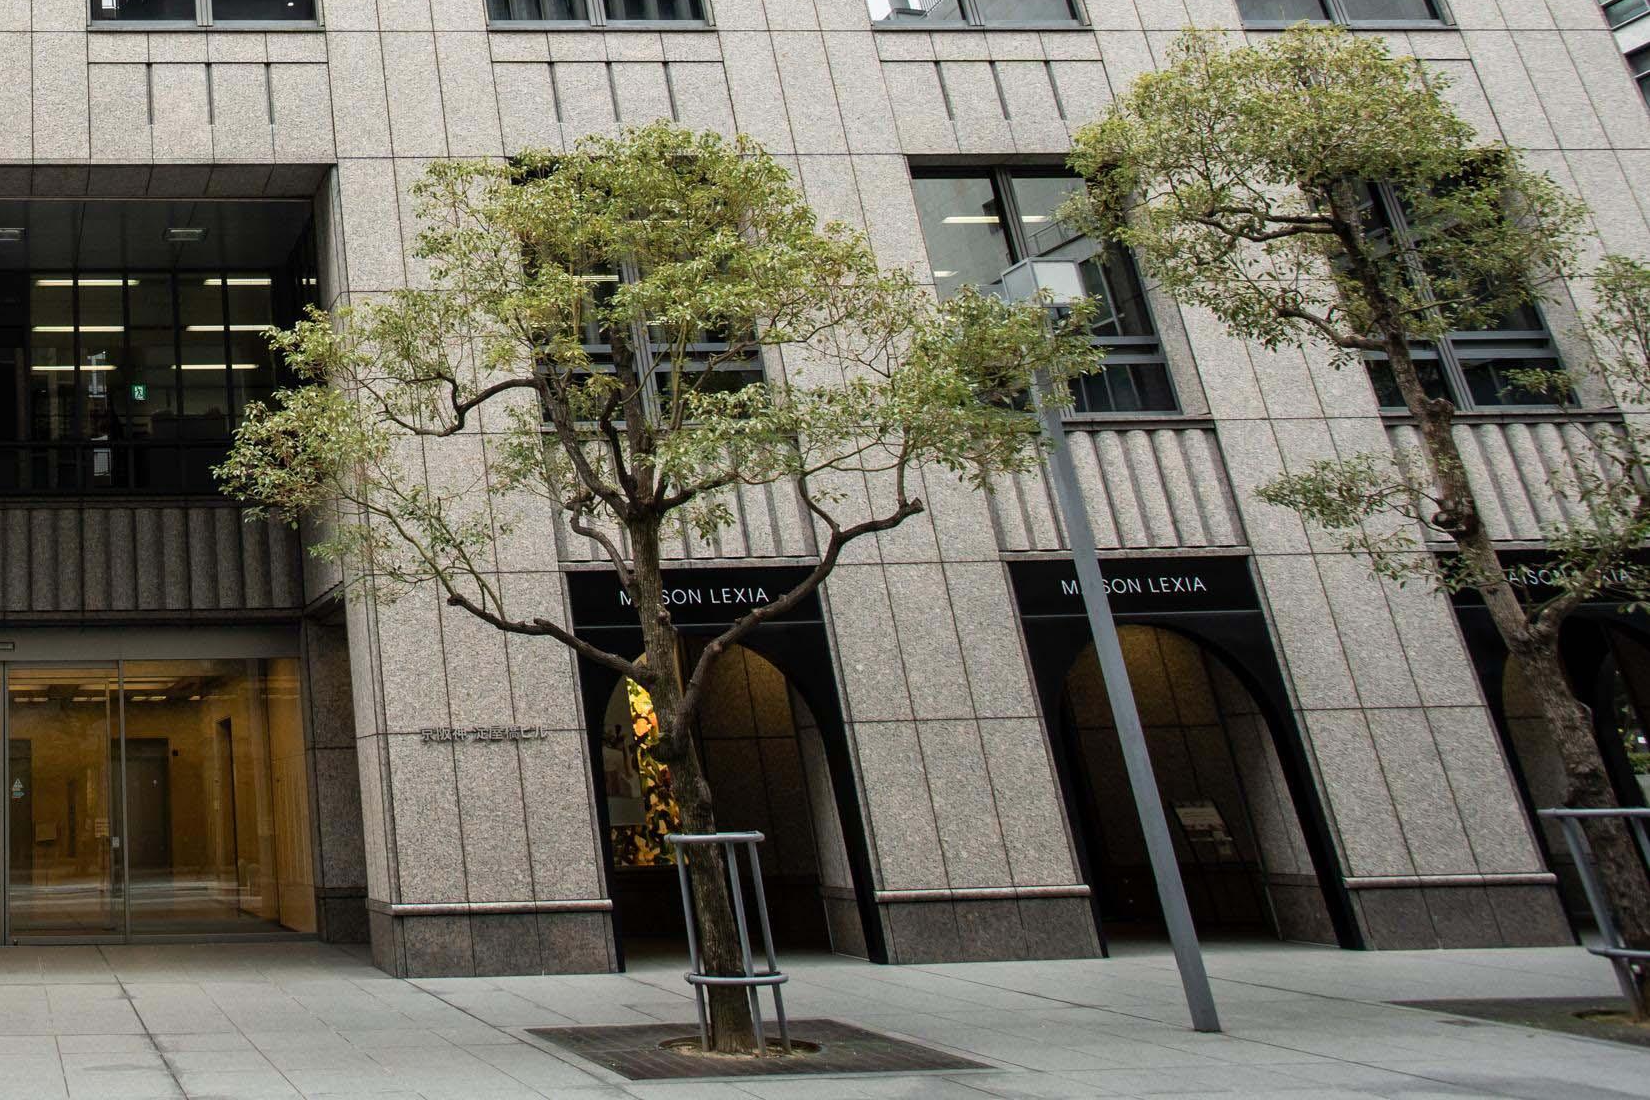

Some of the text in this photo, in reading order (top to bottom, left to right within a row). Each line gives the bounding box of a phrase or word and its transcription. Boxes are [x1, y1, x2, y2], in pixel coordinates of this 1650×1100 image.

[1061, 576, 1207, 595] MSON LEXIA
[619, 587, 770, 606] MSON LEXIA
